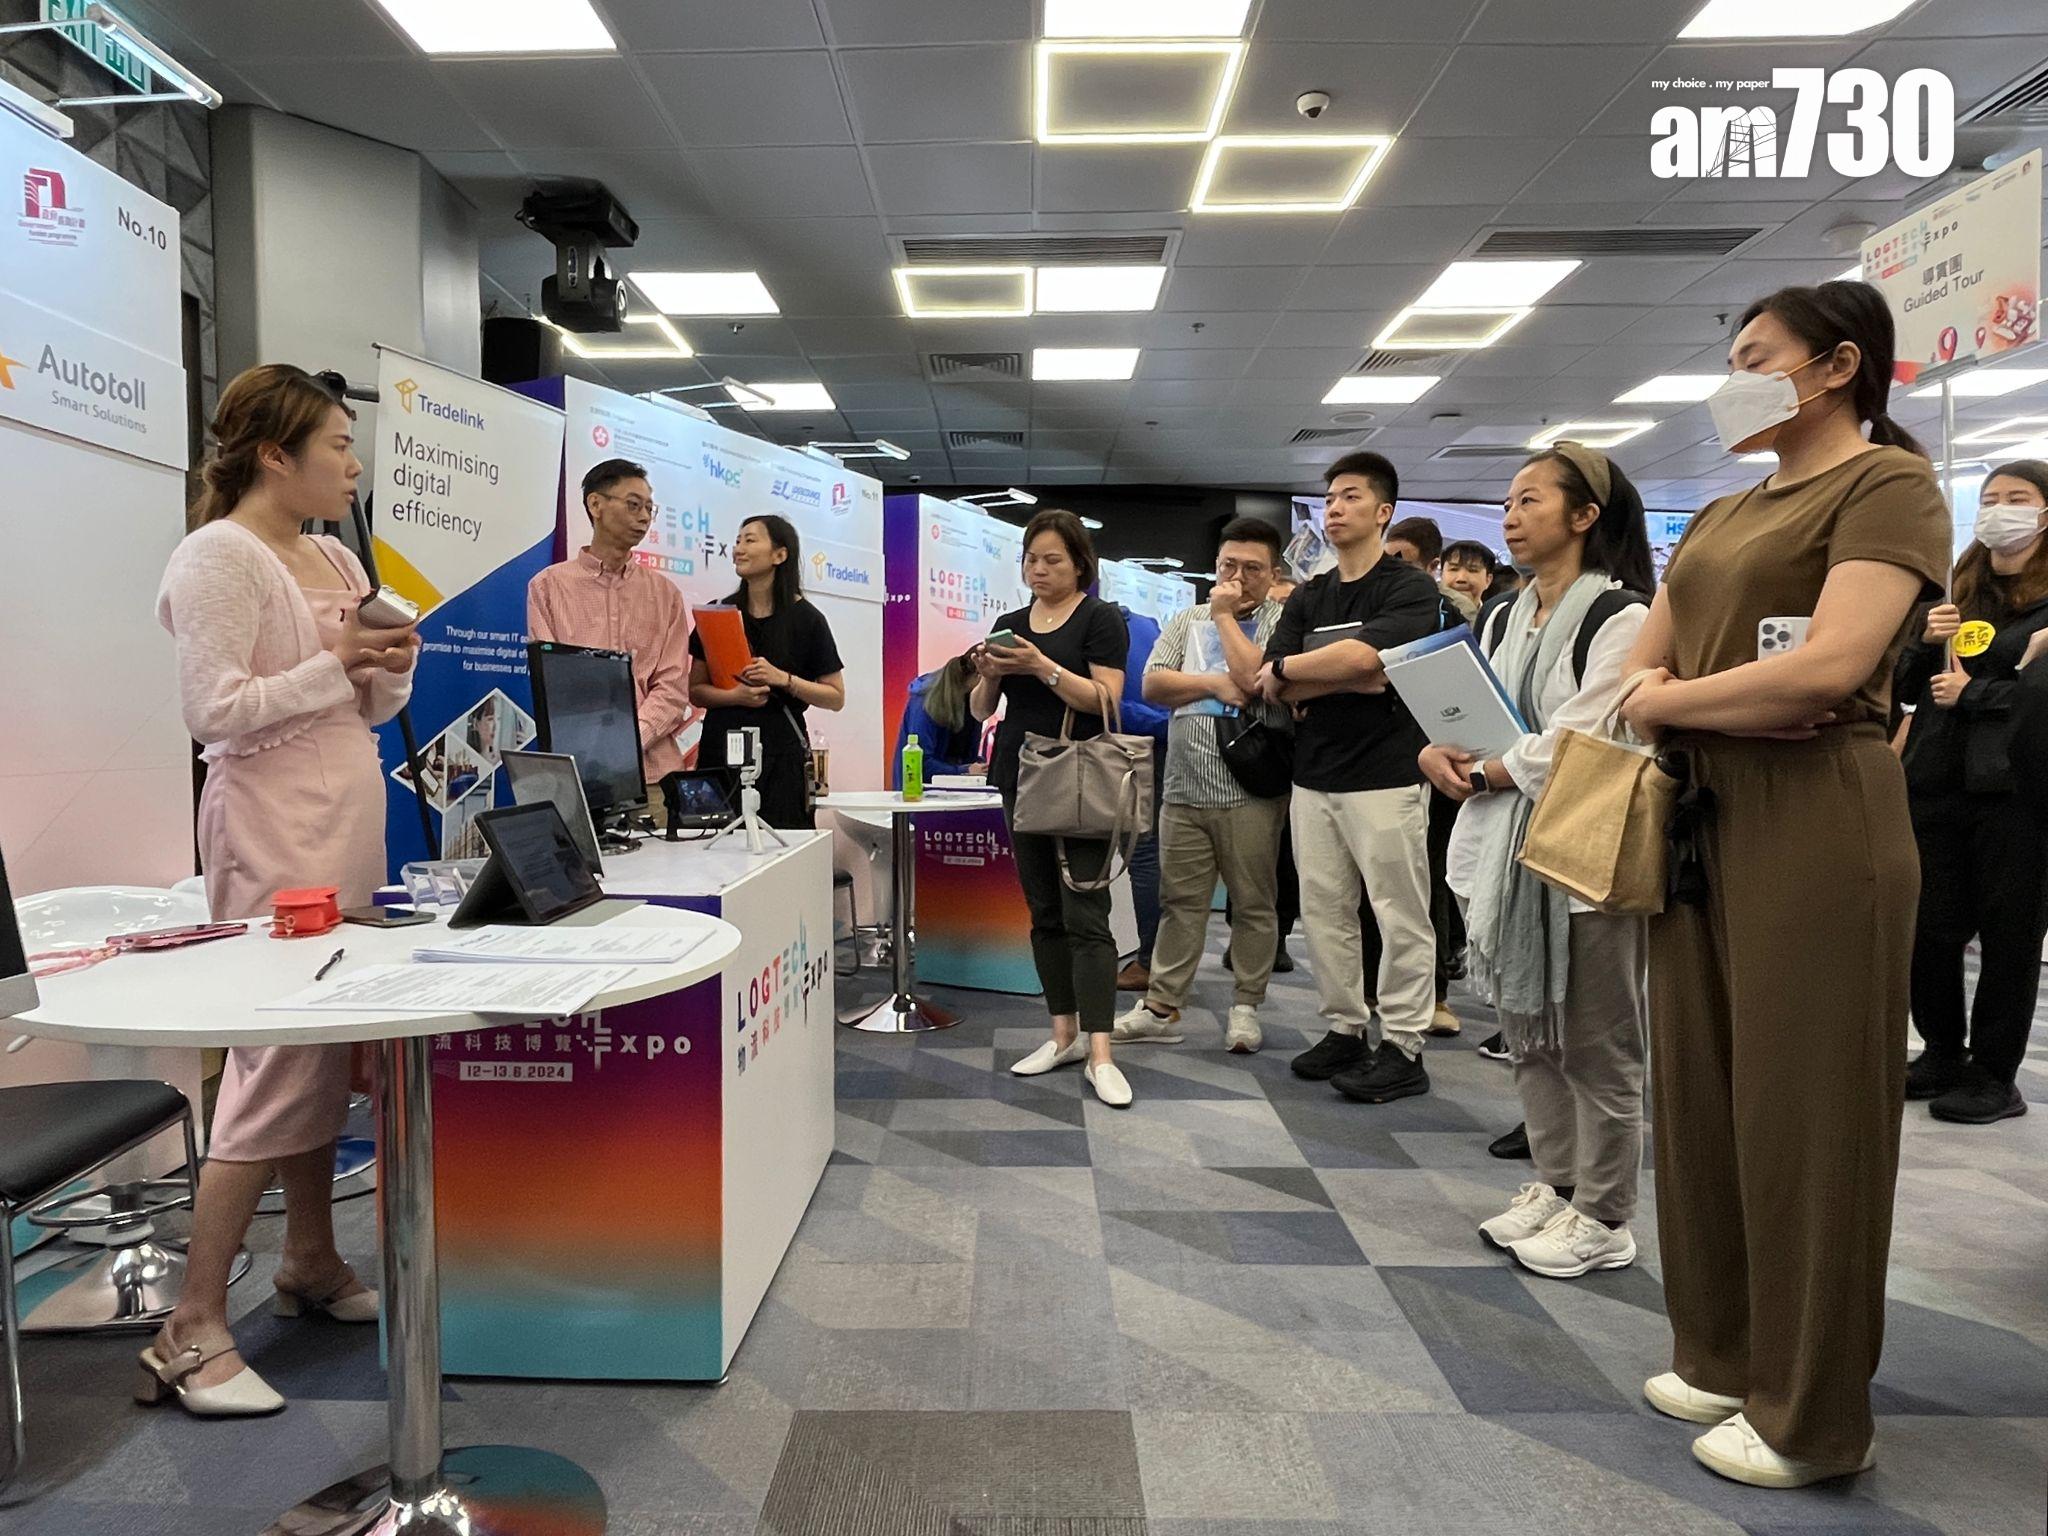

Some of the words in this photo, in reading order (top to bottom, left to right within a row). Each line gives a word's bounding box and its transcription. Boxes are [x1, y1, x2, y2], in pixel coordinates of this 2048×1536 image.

[118, 206, 167, 250] No.10
[1923, 221, 1958, 252] Expo
[1903, 281, 1948, 313] Guided
[1952, 269, 1984, 292] Tour
[38, 344, 146, 411] Autotoll
[52, 390, 89, 416] Smart
[93, 404, 147, 434] Solutions
[418, 393, 485, 431] Tradelink
[395, 432, 499, 486] Maximising
[393, 463, 451, 497] digital
[392, 499, 482, 542] efficiency
[826, 562, 870, 585] Tradelink
[929, 567, 987, 592] LOGTECH
[982, 593, 1008, 617] Expo
[446, 625, 476, 640] Through
[477, 631, 488, 640] our
[490, 632, 509, 642] smart
[511, 633, 519, 642] IT
[1964, 631, 1976, 648] ME
[1977, 626, 1989, 647] ASK
[423, 642, 452, 653] promise
[453, 644, 461, 653] to
[496, 647, 517, 659] digital
[463, 660, 473, 670] for
[474, 661, 512, 673] businesses
[514, 664, 526, 674] and
[924, 829, 996, 847] LOGTECH
[737, 916, 807, 1033] LOGTECH
[592, 1027, 692, 1071] Expo
[467, 1065, 566, 1079] 12-13.6.2024
